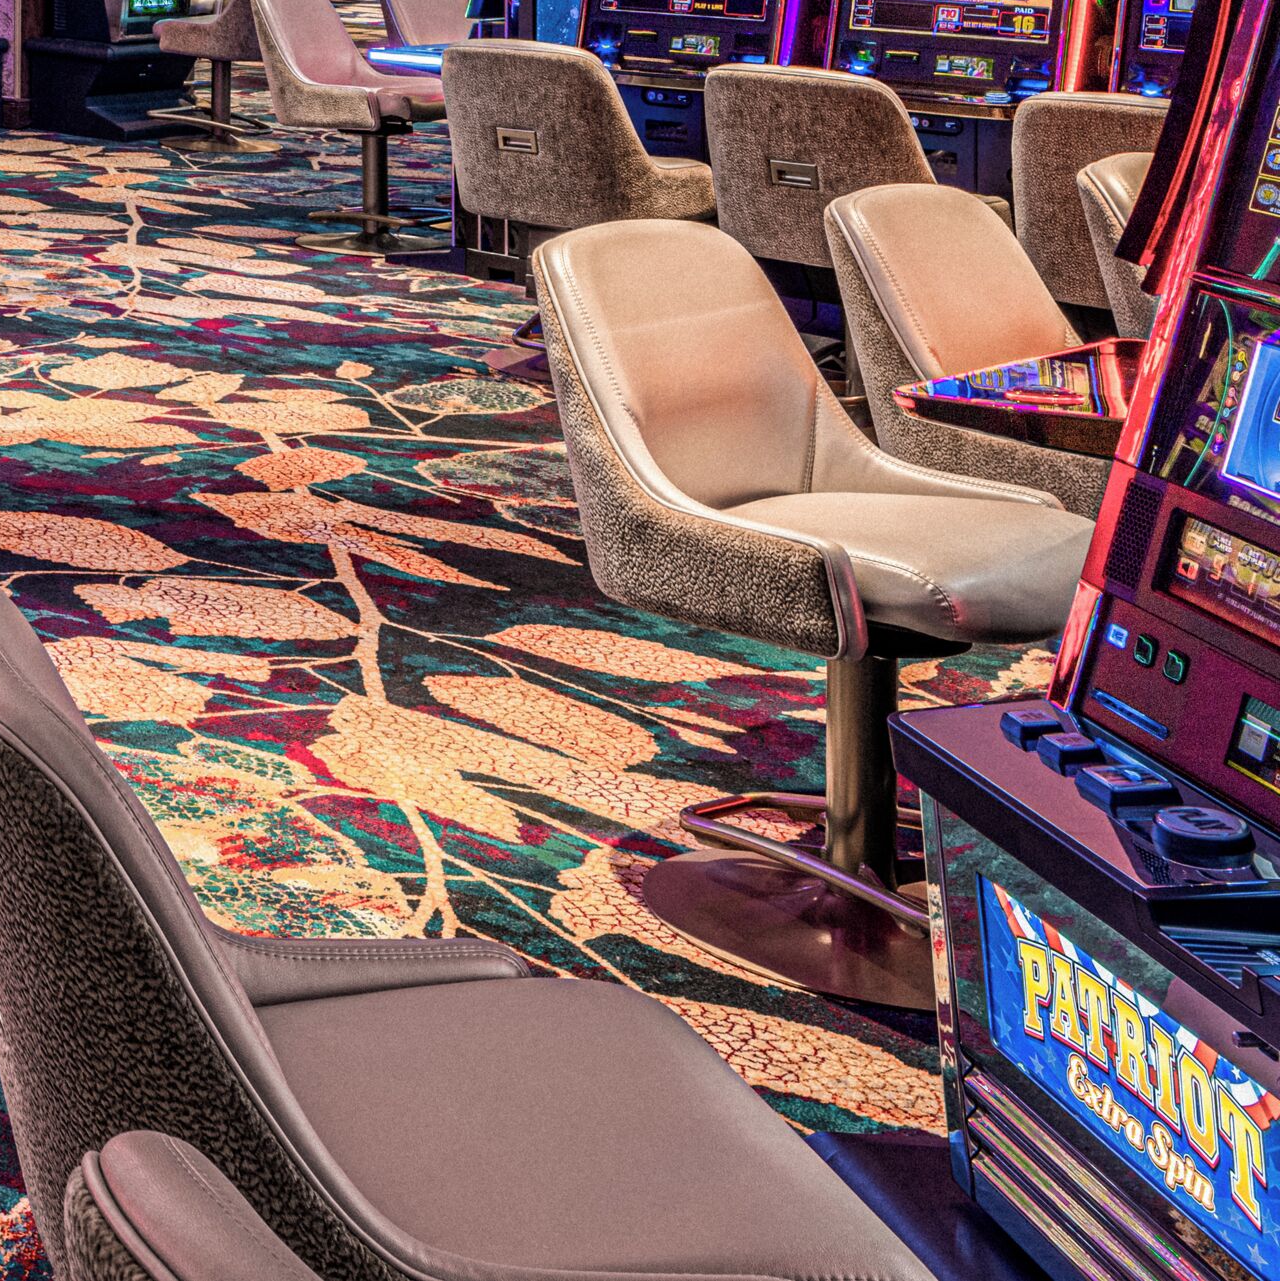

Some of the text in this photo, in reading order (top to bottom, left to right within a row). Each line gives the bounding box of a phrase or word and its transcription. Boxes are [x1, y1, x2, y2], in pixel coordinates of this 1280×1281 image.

[941, 10, 956, 19] $10
[1013, 16, 1034, 34] 16
[1238, 552, 1267, 569] MULTIPLIER
[1248, 550, 1262, 559] BET
[1017, 938, 1267, 1233] PATRIOT
[1068, 1052, 1215, 1213] Extra Spin
